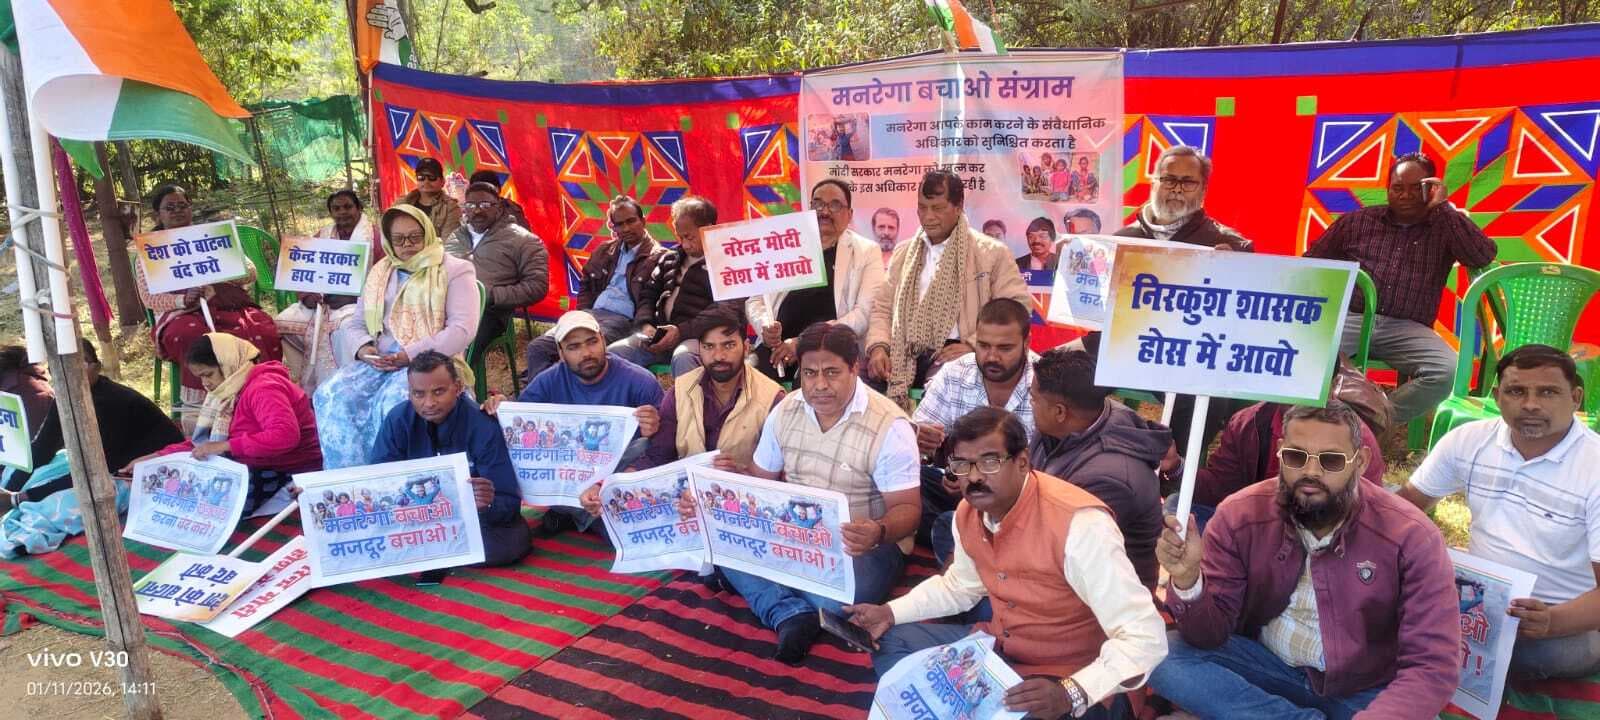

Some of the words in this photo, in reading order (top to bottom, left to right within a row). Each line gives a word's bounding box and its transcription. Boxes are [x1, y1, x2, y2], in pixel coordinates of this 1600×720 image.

[831, 77, 912, 106] मनरेगा
[916, 70, 992, 101] बचाओ
[997, 70, 1075, 98] संग्राम
[886, 118, 927, 133] मनरेगा
[929, 116, 963, 131] आपके
[965, 118, 993, 131] काम
[994, 117, 1023, 130] करने
[1027, 117, 1039, 130] के
[1042, 116, 1106, 130] संवैधानिक
[915, 134, 961, 149] अधिकार
[962, 134, 978, 147] को
[981, 133, 1027, 151] सुनिश्चित
[1031, 137, 1065, 149] करता
[1067, 135, 1076, 149] है
[829, 163, 849, 177] मोदी
[851, 167, 881, 177] सरकार
[883, 163, 921, 176] मनरेगा
[967, 163, 985, 173] कर
[875, 180, 916, 193] अधिकार
[978, 177, 985, 191] है
[144, 243, 170, 260] देश
[170, 238, 192, 257] को
[192, 233, 232, 253] बांटना
[721, 236, 762, 257] नरेन्द्र
[763, 228, 801, 250] मोदी
[169, 260, 193, 278] बंद
[193, 255, 221, 275] करो
[288, 245, 316, 263] केन्द्र
[319, 251, 361, 266] सरकार
[291, 269, 316, 283] हाय
[327, 271, 352, 286] हाय
[720, 265, 752, 286] होश
[754, 261, 770, 280] में
[774, 256, 813, 279] आवो
[1131, 273, 1232, 325] निरकुंश
[1236, 289, 1328, 325] शासक
[1138, 327, 1191, 366] होस
[1196, 332, 1225, 370] में
[1226, 339, 1299, 376] आवो
[518, 467, 556, 481] करना
[152, 511, 177, 528] करना
[324, 506, 390, 533] मनरेगा
[394, 497, 453, 522] बचाओ
[618, 503, 674, 523] मनरेगा
[627, 524, 676, 544] मजदूर
[675, 520, 700, 535] बच
[712, 506, 772, 535] मनरेगा
[775, 521, 832, 548] बचाओ
[328, 536, 386, 559] मजदूर
[388, 523, 447, 549] बचाओ
[716, 528, 768, 559] मजदूर
[768, 541, 825, 569] बचाओ
[179, 562, 213, 580] करो
[207, 566, 238, 587] बंद
[175, 586, 204, 606] को
